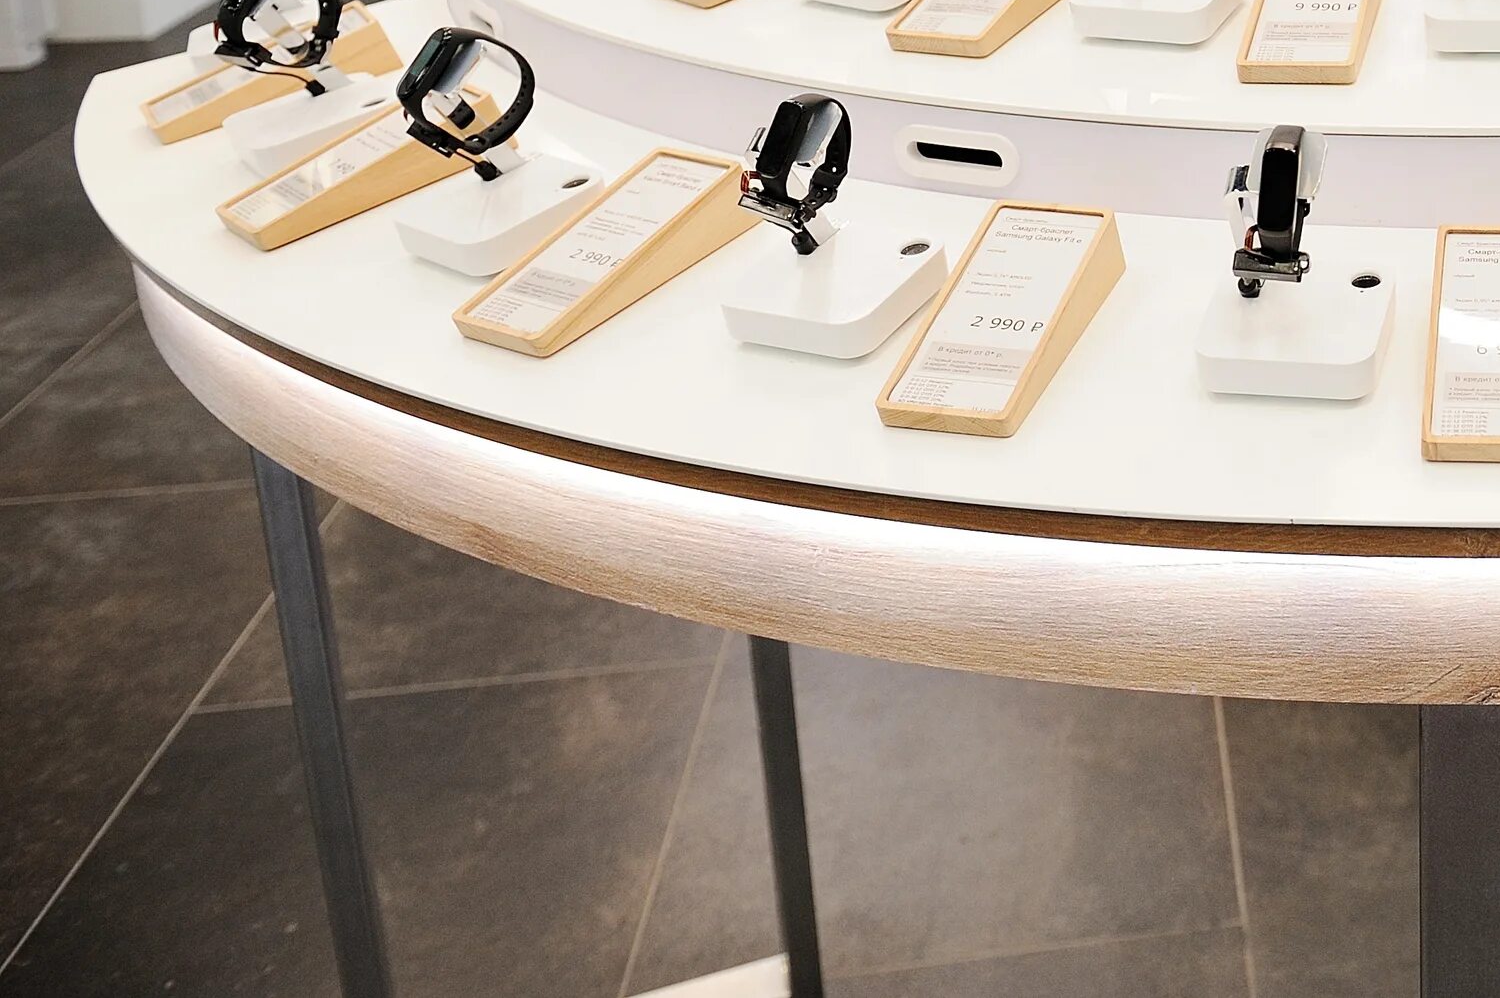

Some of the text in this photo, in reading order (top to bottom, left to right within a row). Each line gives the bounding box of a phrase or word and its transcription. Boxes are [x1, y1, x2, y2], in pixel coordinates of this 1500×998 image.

[1295, 3, 1305, 11] 9
[1311, 3, 1341, 11] 990
[1011, 225, 1074, 235] Смарт-браслет
[995, 231, 1034, 241] Samsung
[1035, 233, 1062, 243] Galaxy
[1064, 235, 1075, 243] Fit
[569, 248, 583, 259] 2
[583, 251, 611, 267] 990
[970, 316, 983, 327] 2
[989, 318, 1025, 332] 990
